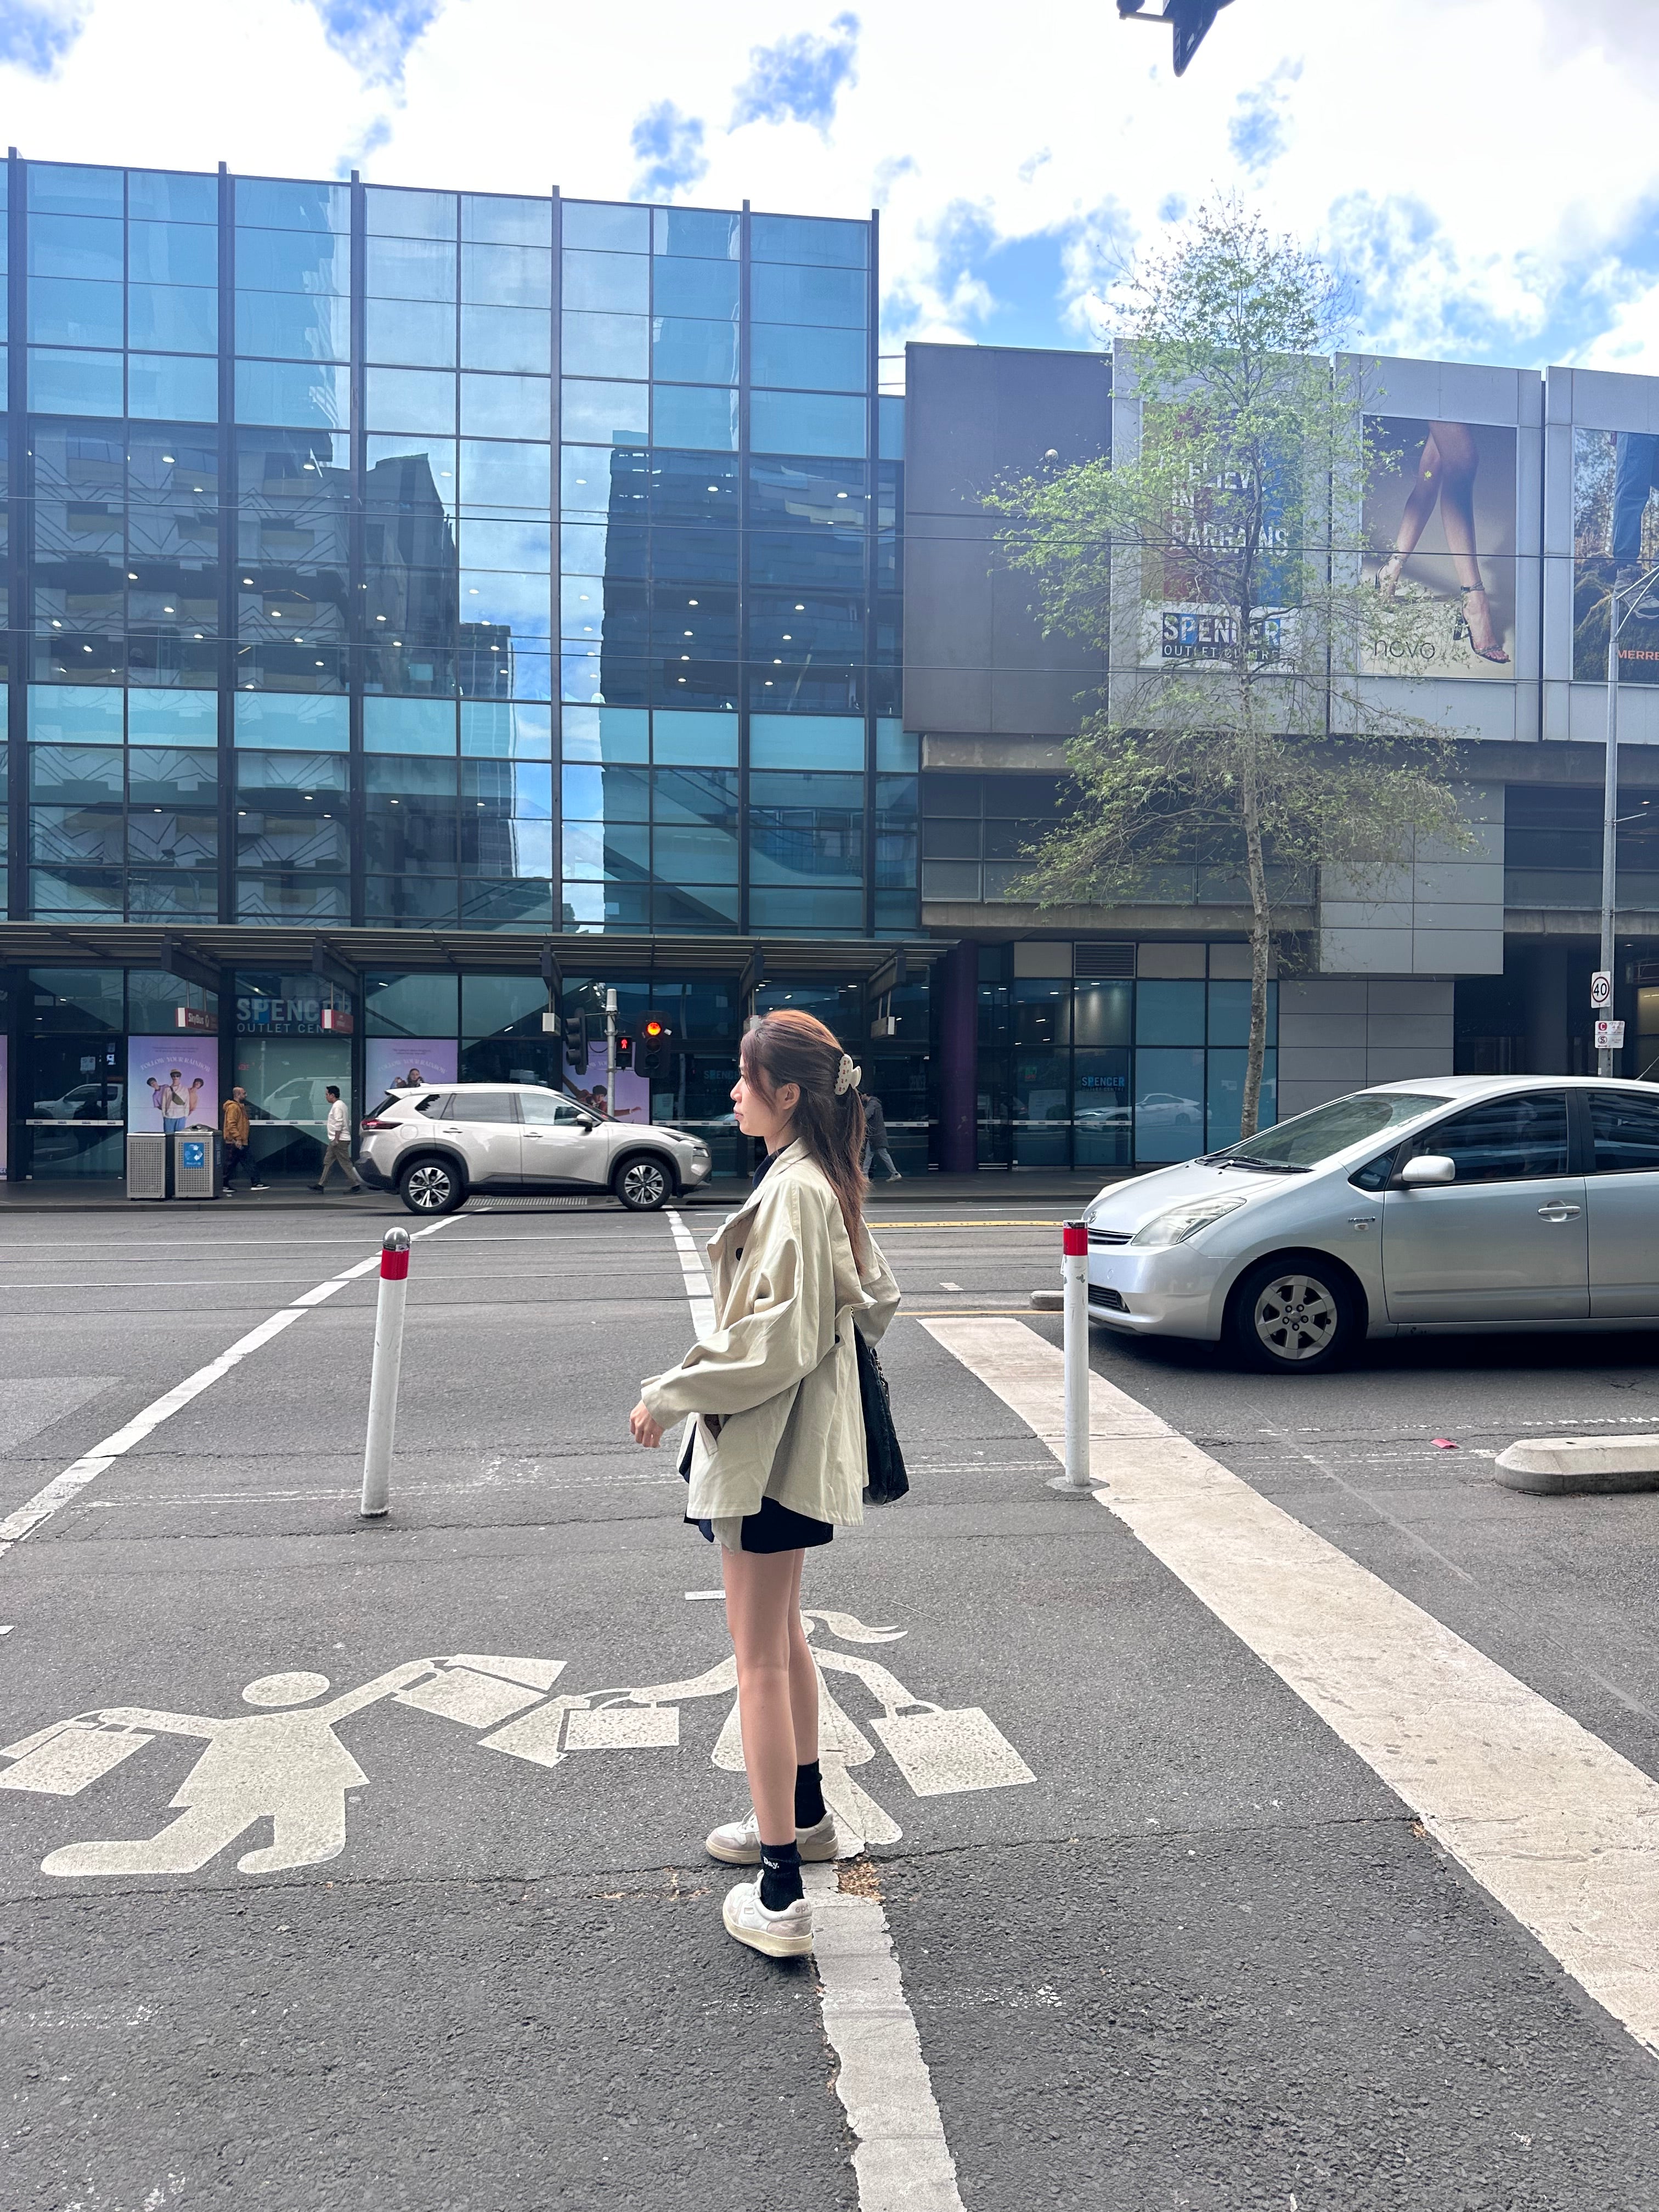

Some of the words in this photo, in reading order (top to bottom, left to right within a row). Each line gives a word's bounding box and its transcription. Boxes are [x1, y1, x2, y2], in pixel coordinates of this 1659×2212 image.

[1374, 640, 1435, 659] novo
[1594, 983, 1607, 996] 40
[237, 1024, 291, 1032] OUTLET
[1082, 1076, 1124, 1086] SPENCER
